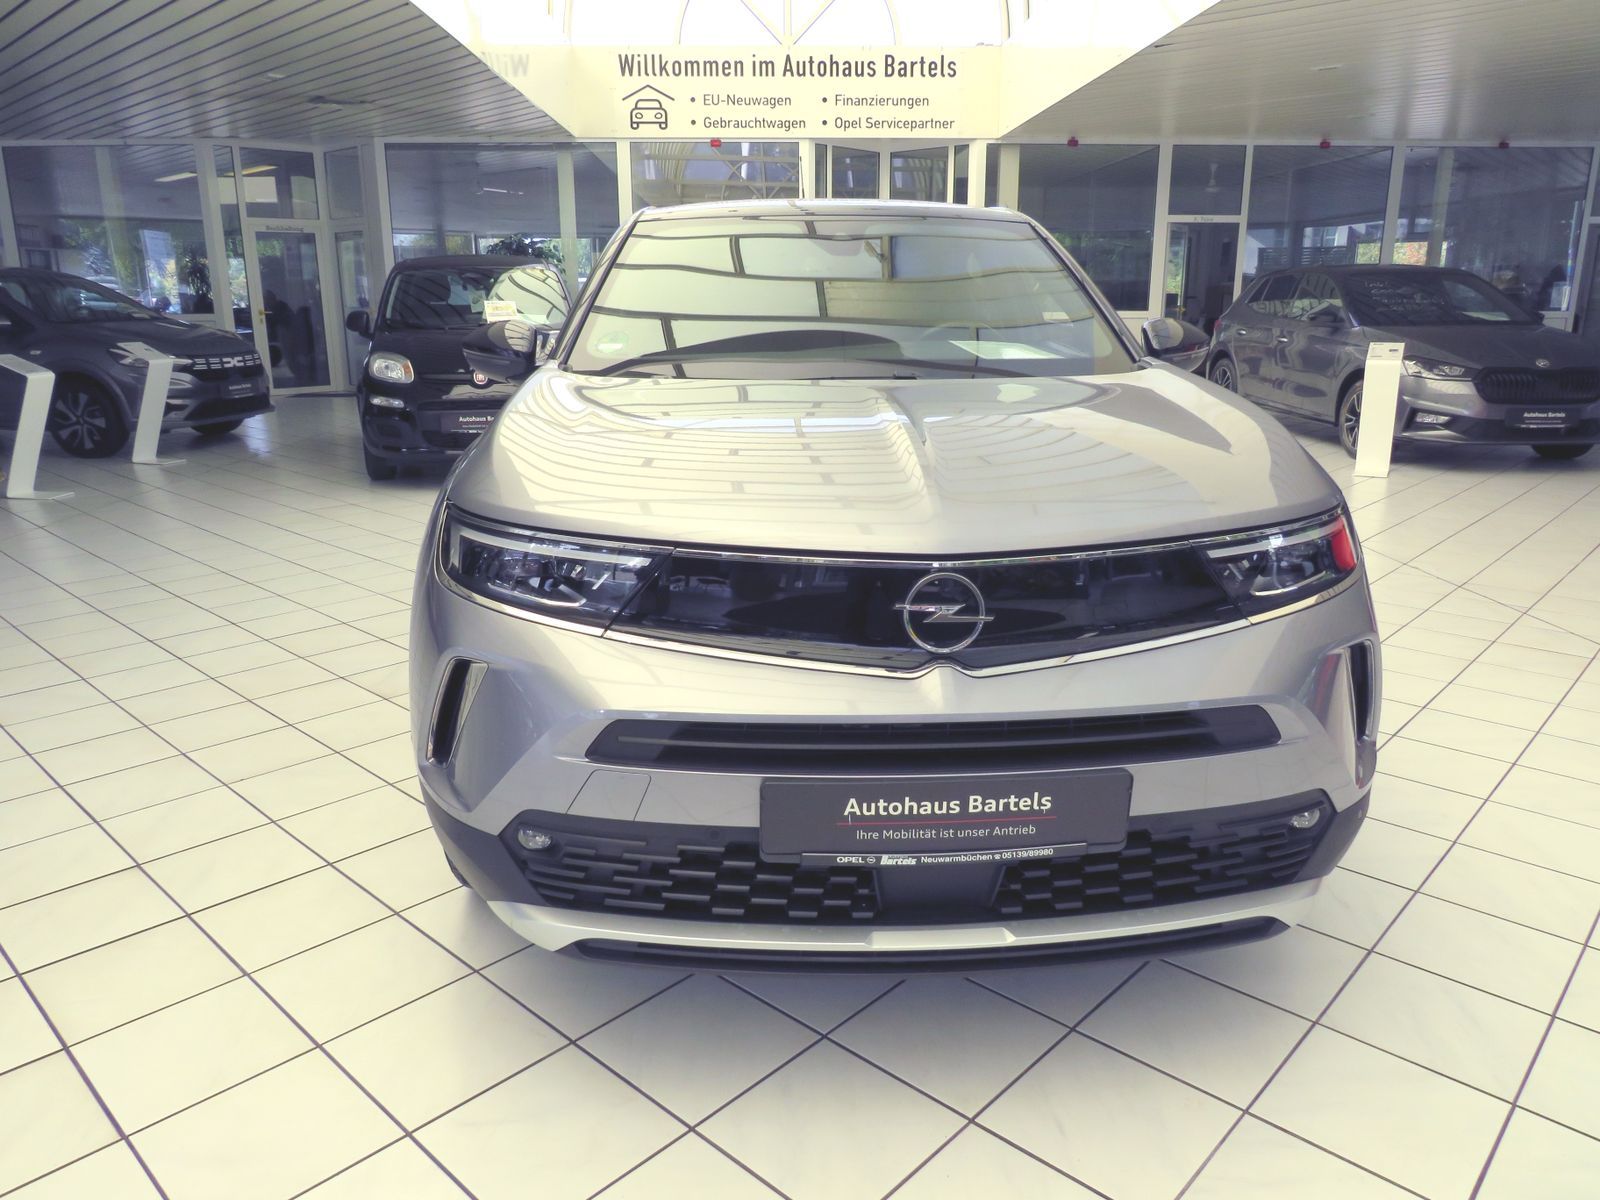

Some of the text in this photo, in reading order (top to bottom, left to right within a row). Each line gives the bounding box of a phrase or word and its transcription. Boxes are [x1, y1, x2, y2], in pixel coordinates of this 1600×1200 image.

[618, 54, 957, 78] Willkommen im Autohaus Bartels
[703, 94, 792, 110] EU-Neuwagen
[835, 94, 930, 110] Finanzierungen
[703, 116, 806, 132] Gebrauchtwagen
[834, 116, 955, 132] Opel Servicepartner
[843, 792, 1052, 817] Autohaus Bartels
[856, 824, 1037, 840] Ihre Mobilität ist unser Antrieb
[836, 856, 866, 864] OPEL
[920, 852, 993, 863] Neuwarmbüchen
[1001, 849, 1054, 859] 05139/89980
